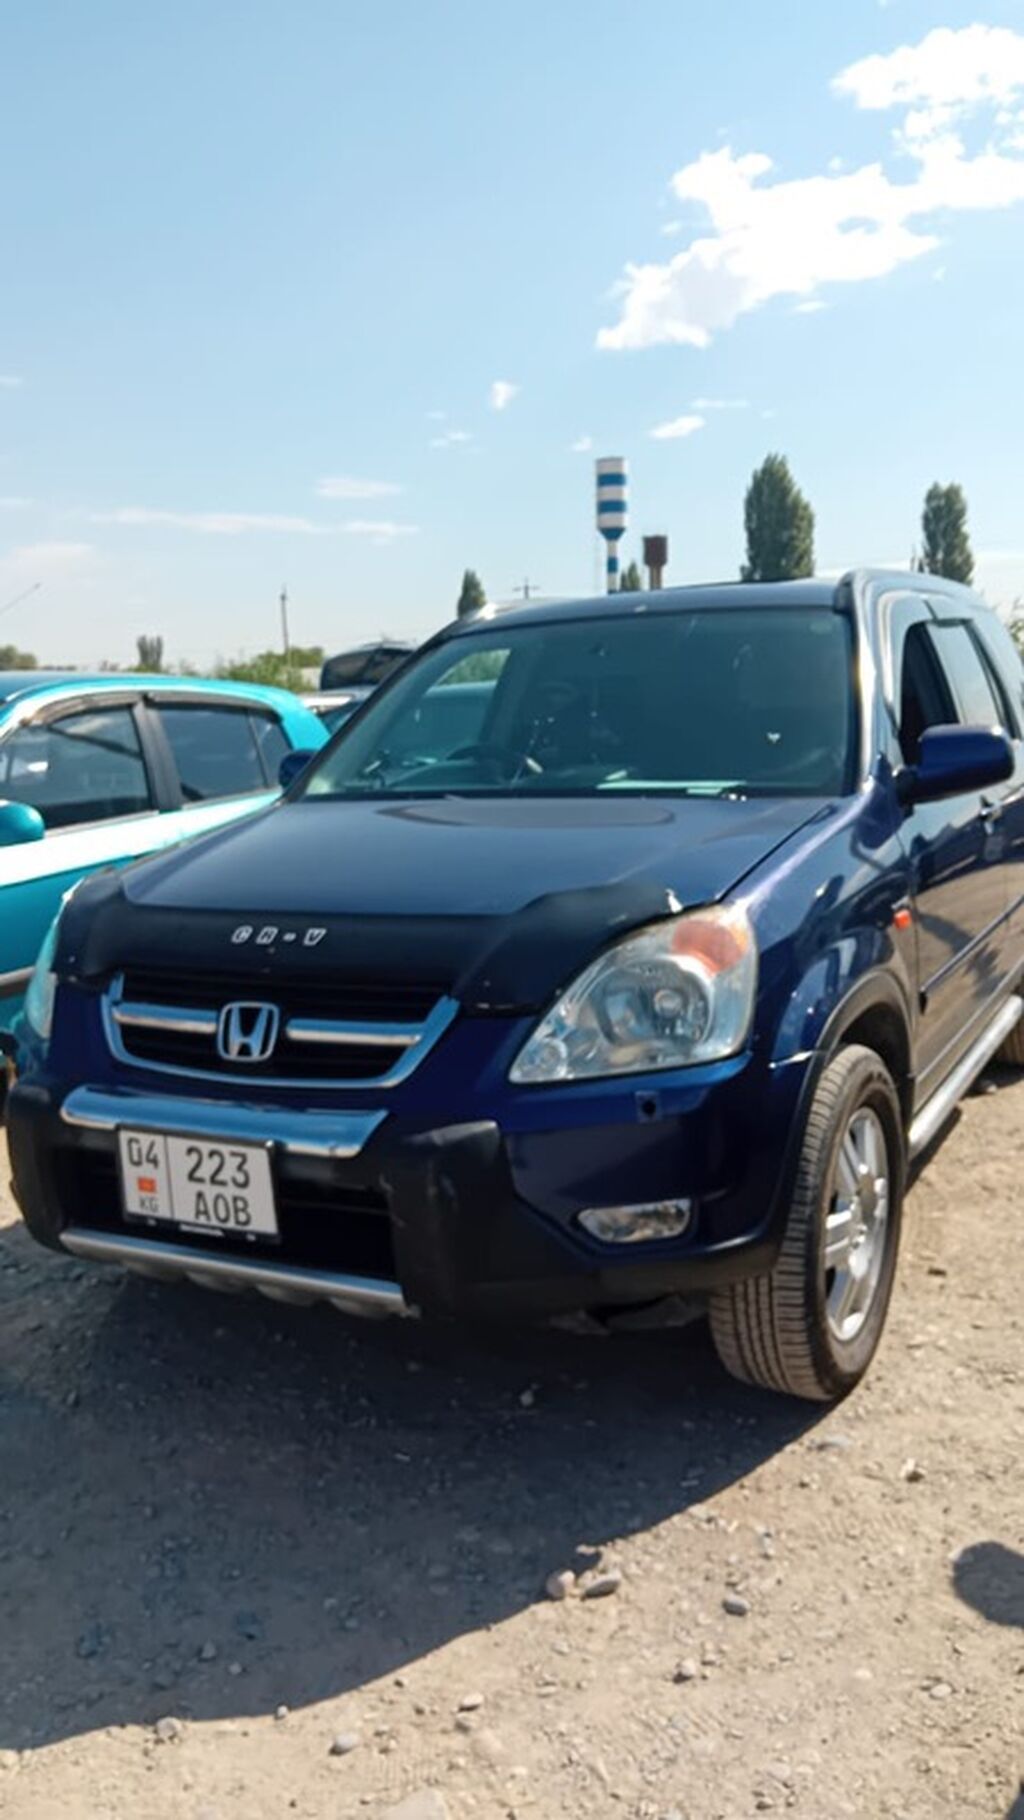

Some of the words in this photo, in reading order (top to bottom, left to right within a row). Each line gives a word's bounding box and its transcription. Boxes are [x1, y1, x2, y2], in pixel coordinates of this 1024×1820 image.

[127, 1137, 159, 1169] 04
[186, 1146, 251, 1189] 223
[138, 1197, 159, 1213] KG
